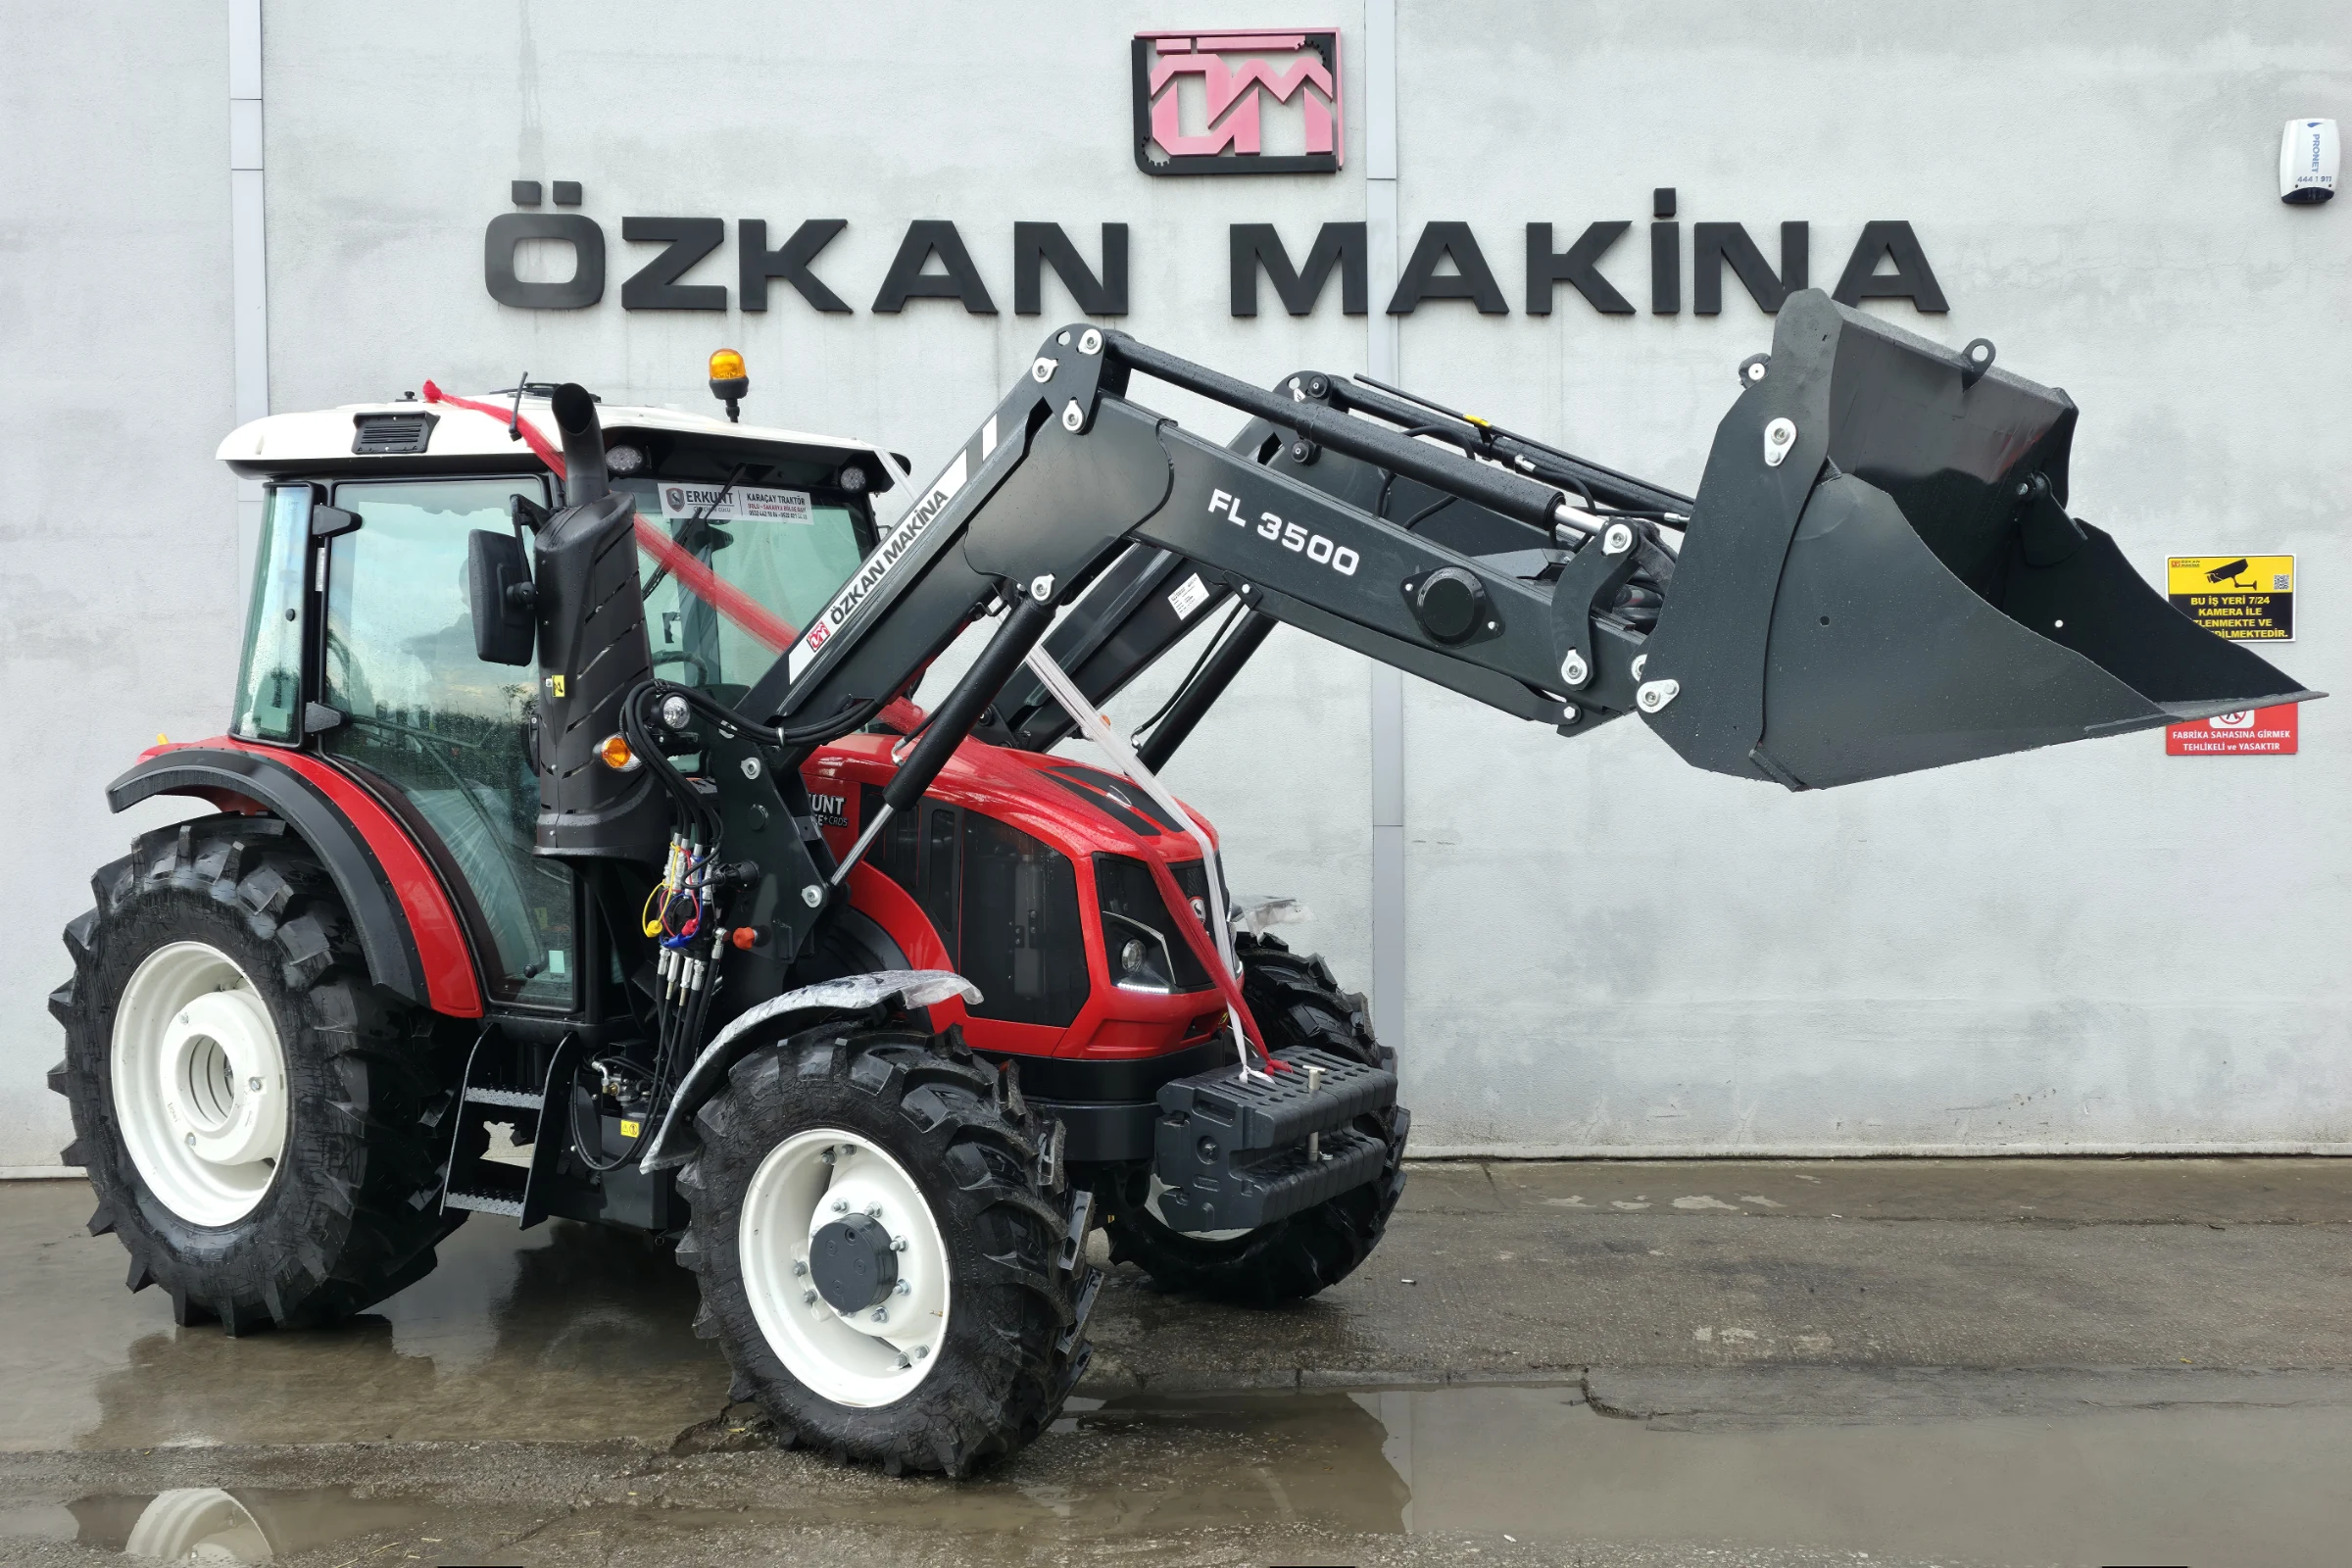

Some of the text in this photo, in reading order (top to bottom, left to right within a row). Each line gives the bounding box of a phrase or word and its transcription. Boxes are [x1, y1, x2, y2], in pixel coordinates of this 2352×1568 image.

[2311, 133, 2321, 173] PRONET
[484, 179, 1951, 317] ÖZKAN MAKİNA
[747, 493, 806, 505] KARAÇAY TRAKTÖR
[1207, 488, 1360, 576] FL 3500
[829, 489, 950, 625] ÖZKAN MAKİNA
[2190, 595, 2271, 608] BU İŞ YERİ 7/24
[2198, 606, 2263, 616] KAMERA İLE
[2258, 618, 2273, 627] VE
[2173, 728, 2290, 739] FABRİKA SAHASINA GİRMEK
[2183, 742, 2226, 751] TEHLİKELİ
[2238, 742, 2280, 751] YASAKTIR
[809, 794, 845, 815] UNT
